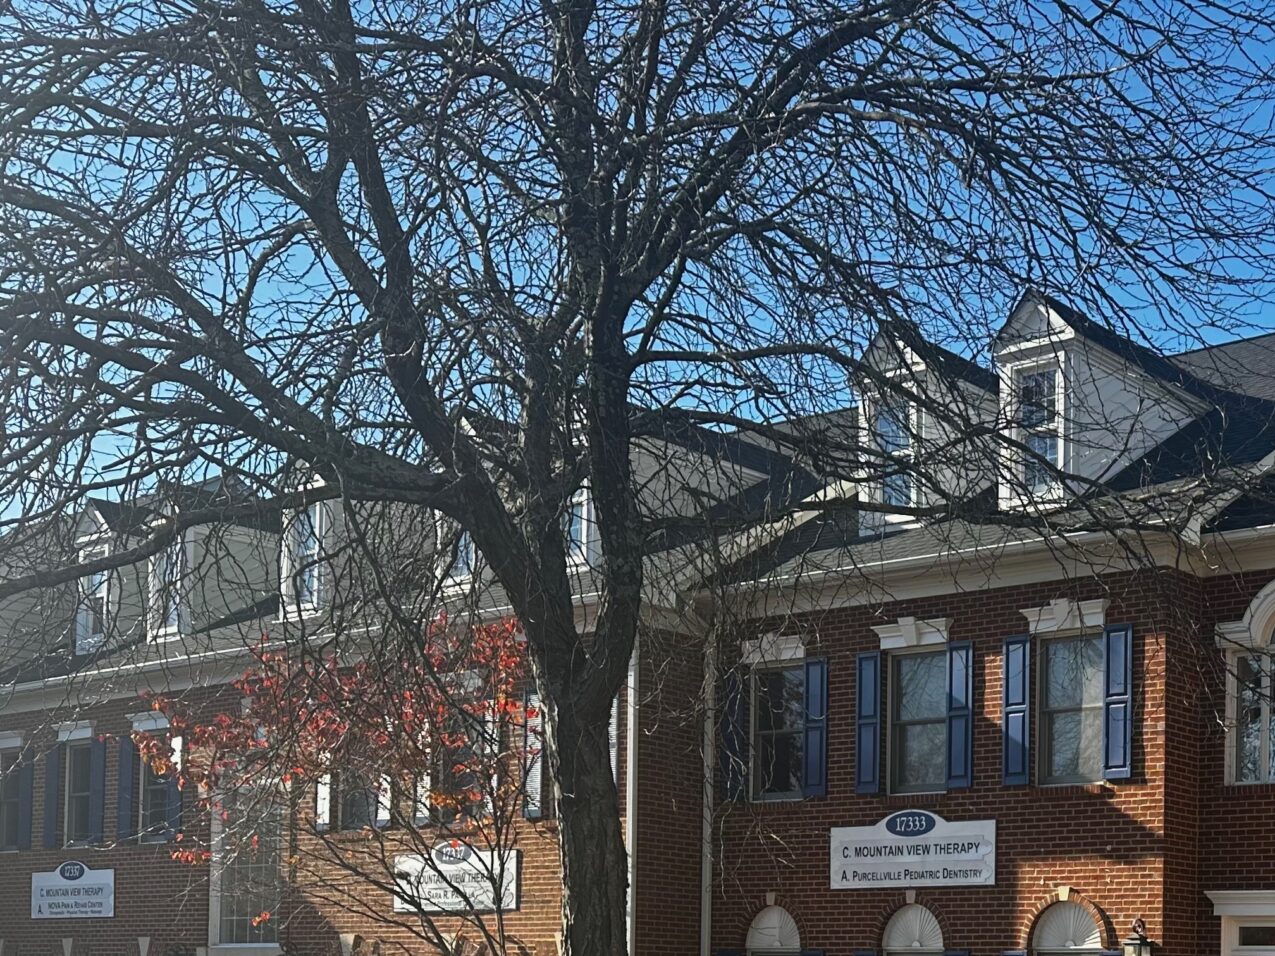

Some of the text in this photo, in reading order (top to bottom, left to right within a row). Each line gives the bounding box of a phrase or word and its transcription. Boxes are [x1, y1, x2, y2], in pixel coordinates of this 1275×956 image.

[895, 816, 926, 832] 17333
[842, 841, 981, 859] C. MOUNTAIN VIEW THERAPY
[414, 873, 450, 885] MOUNTA
[841, 869, 850, 881] A.
